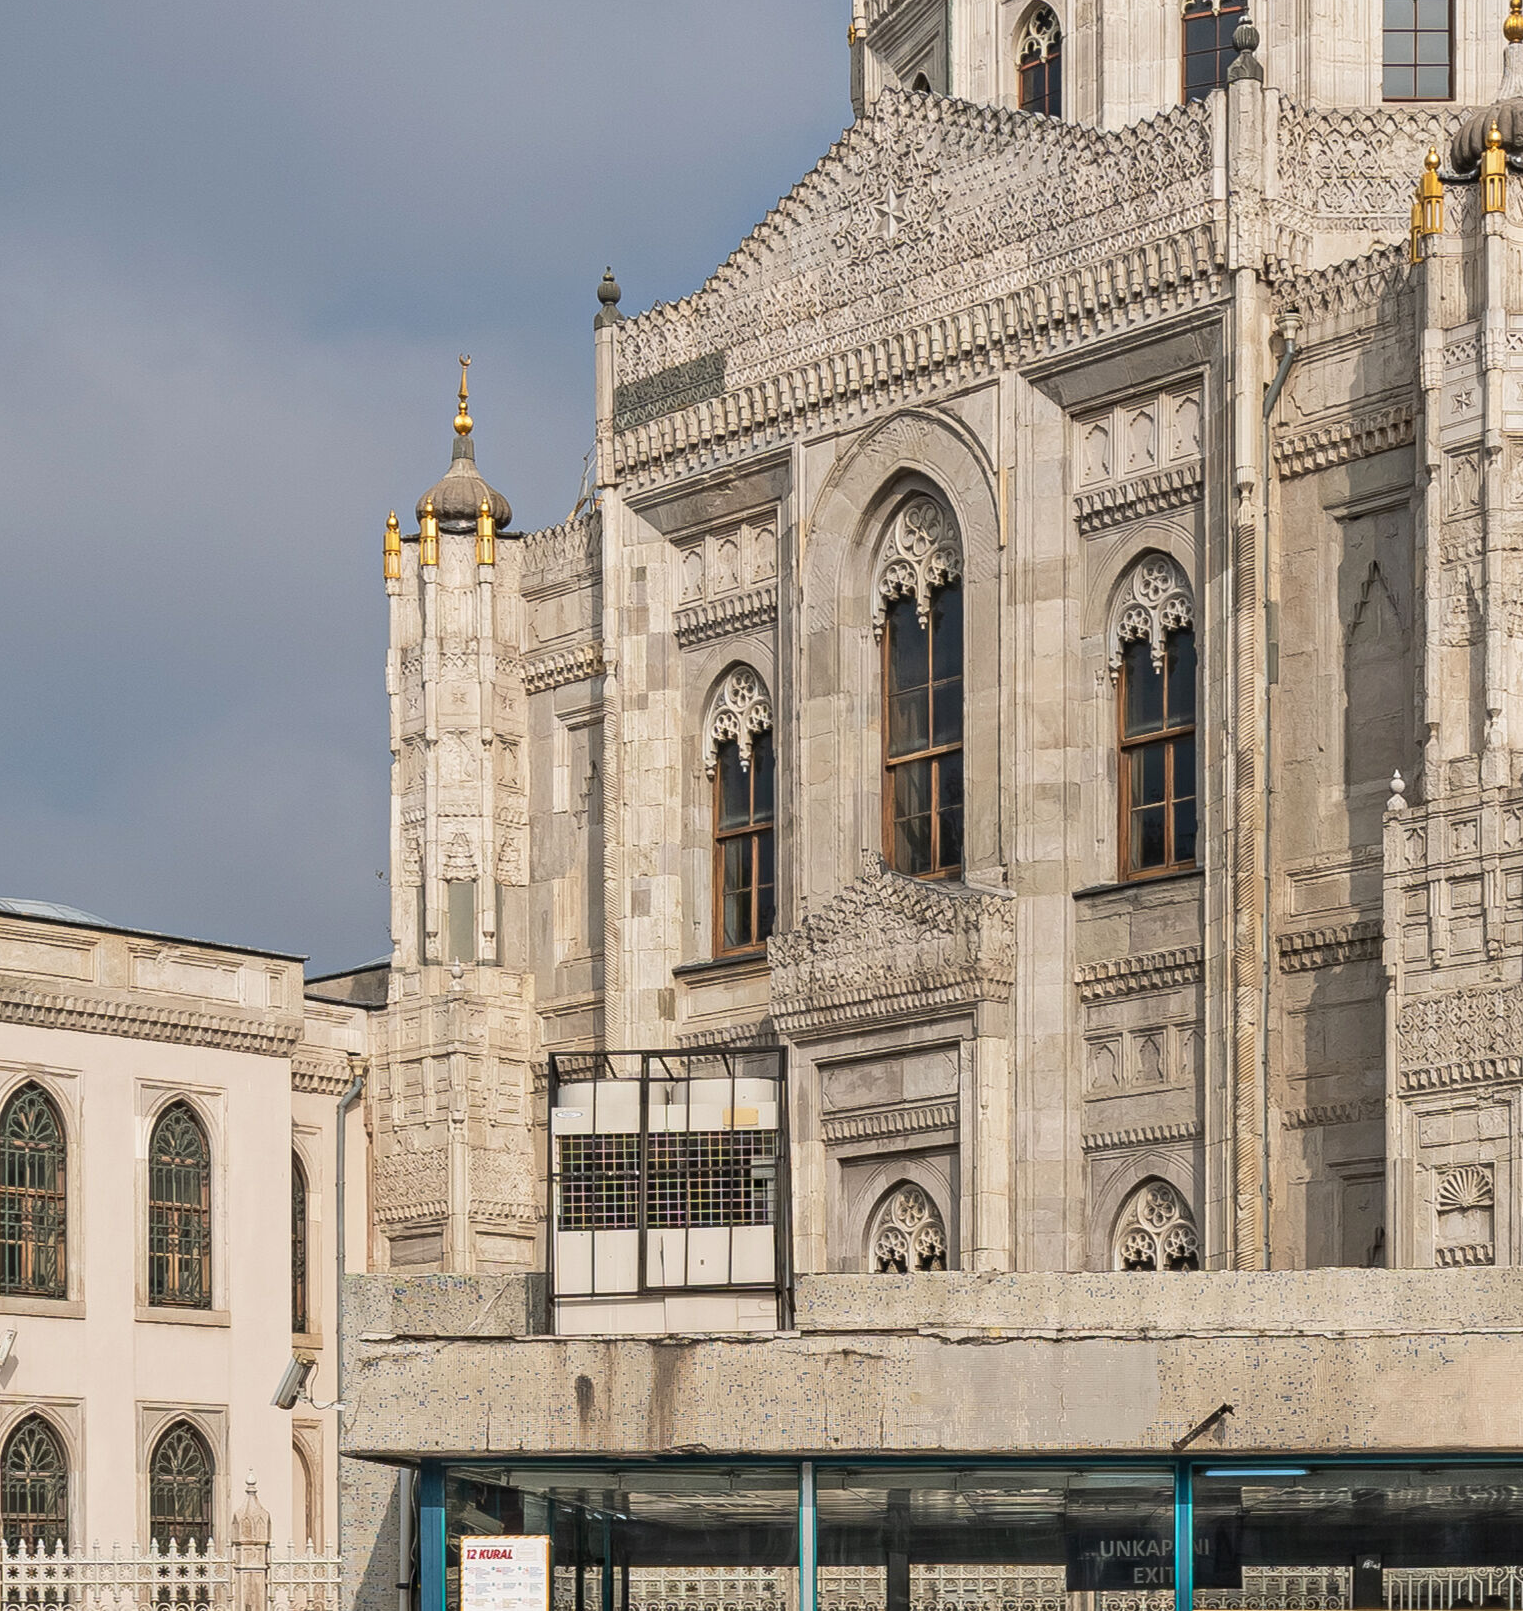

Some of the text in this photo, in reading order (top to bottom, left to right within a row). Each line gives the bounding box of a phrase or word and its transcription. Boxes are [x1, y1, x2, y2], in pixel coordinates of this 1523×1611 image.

[467, 1549, 513, 1560] 12 KURAL
[1100, 1539, 1210, 1557] UNKAPNI
[1133, 1567, 1175, 1584] EXIT
